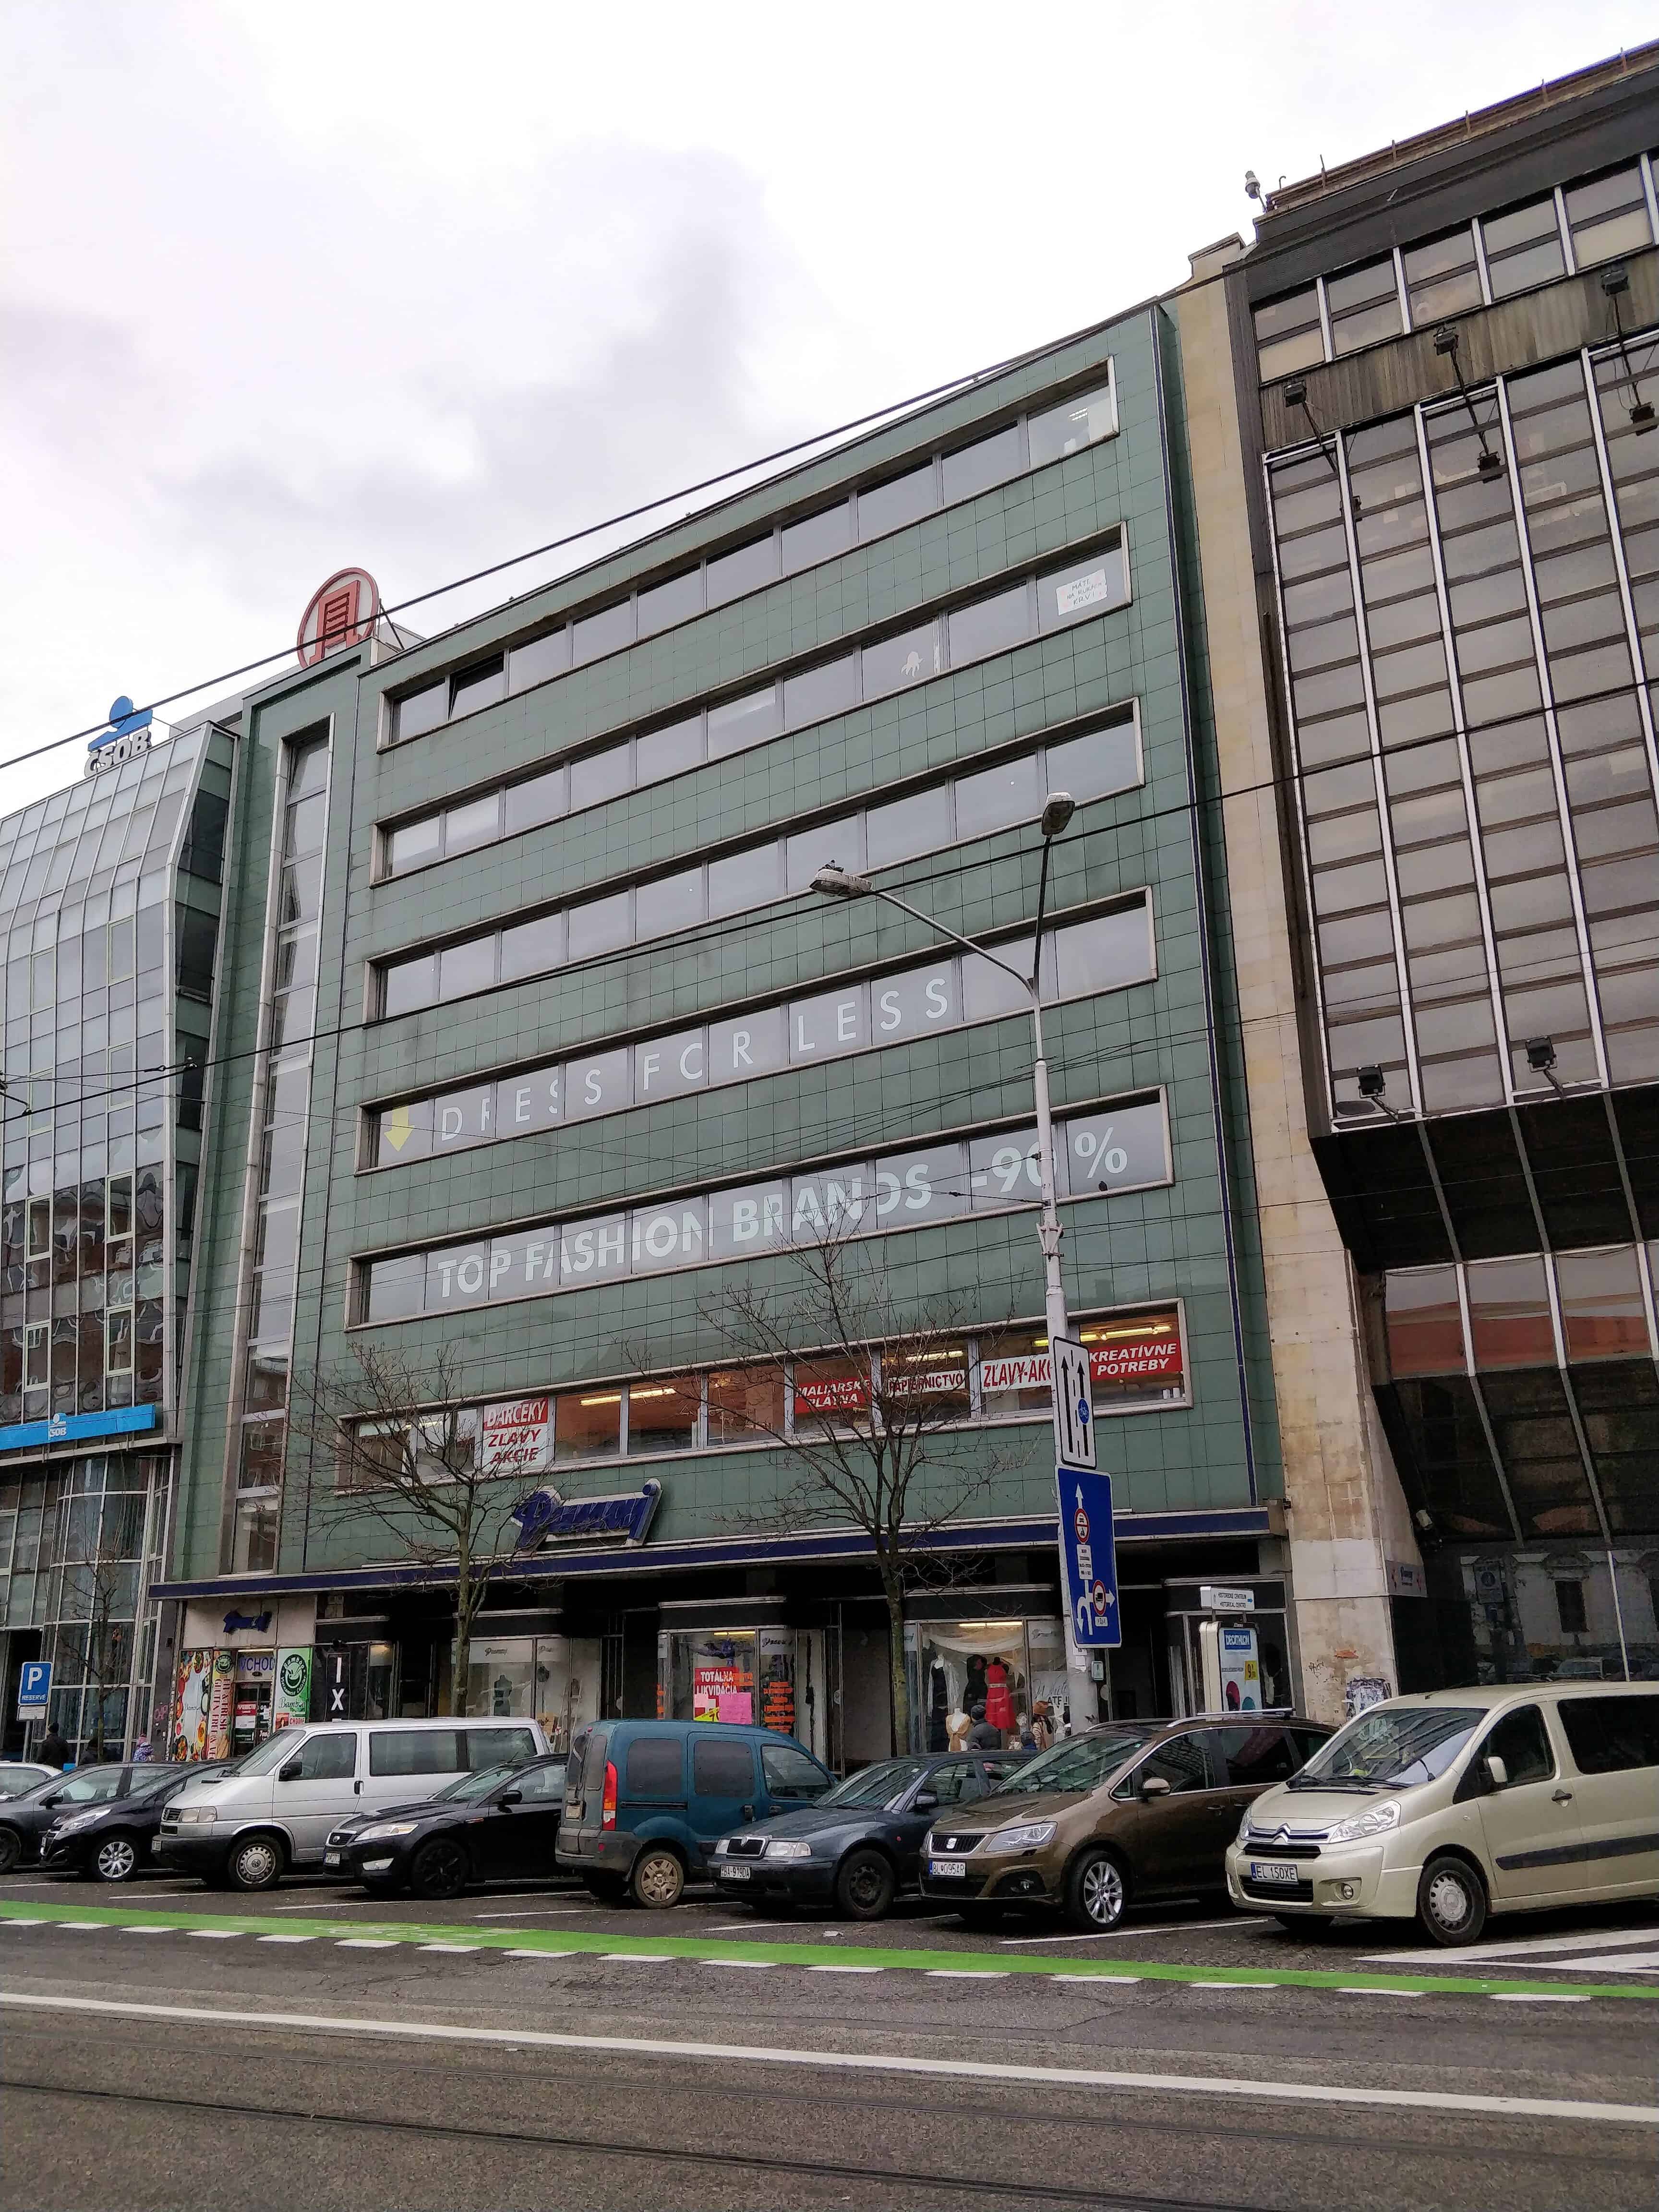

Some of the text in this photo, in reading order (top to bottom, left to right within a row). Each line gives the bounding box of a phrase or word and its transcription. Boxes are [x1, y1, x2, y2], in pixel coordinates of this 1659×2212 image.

[798, 978, 948, 1052] LESS
[437, 1249, 512, 1298] TOP
[526, 1206, 714, 1282] FASHION
[733, 1164, 933, 1242] BRANDS
[1090, 1343, 1177, 1363] KREATÍVNE
[1097, 1358, 1169, 1376] POTREBY
[889, 1373, 963, 1392] PAPIERNICTVO
[490, 1447, 539, 1465] AKCIE
[27, 1667, 42, 1690] P
[700, 1669, 734, 1683] TOTÁLNA
[1256, 1866, 1296, 1880] EL 150XE
